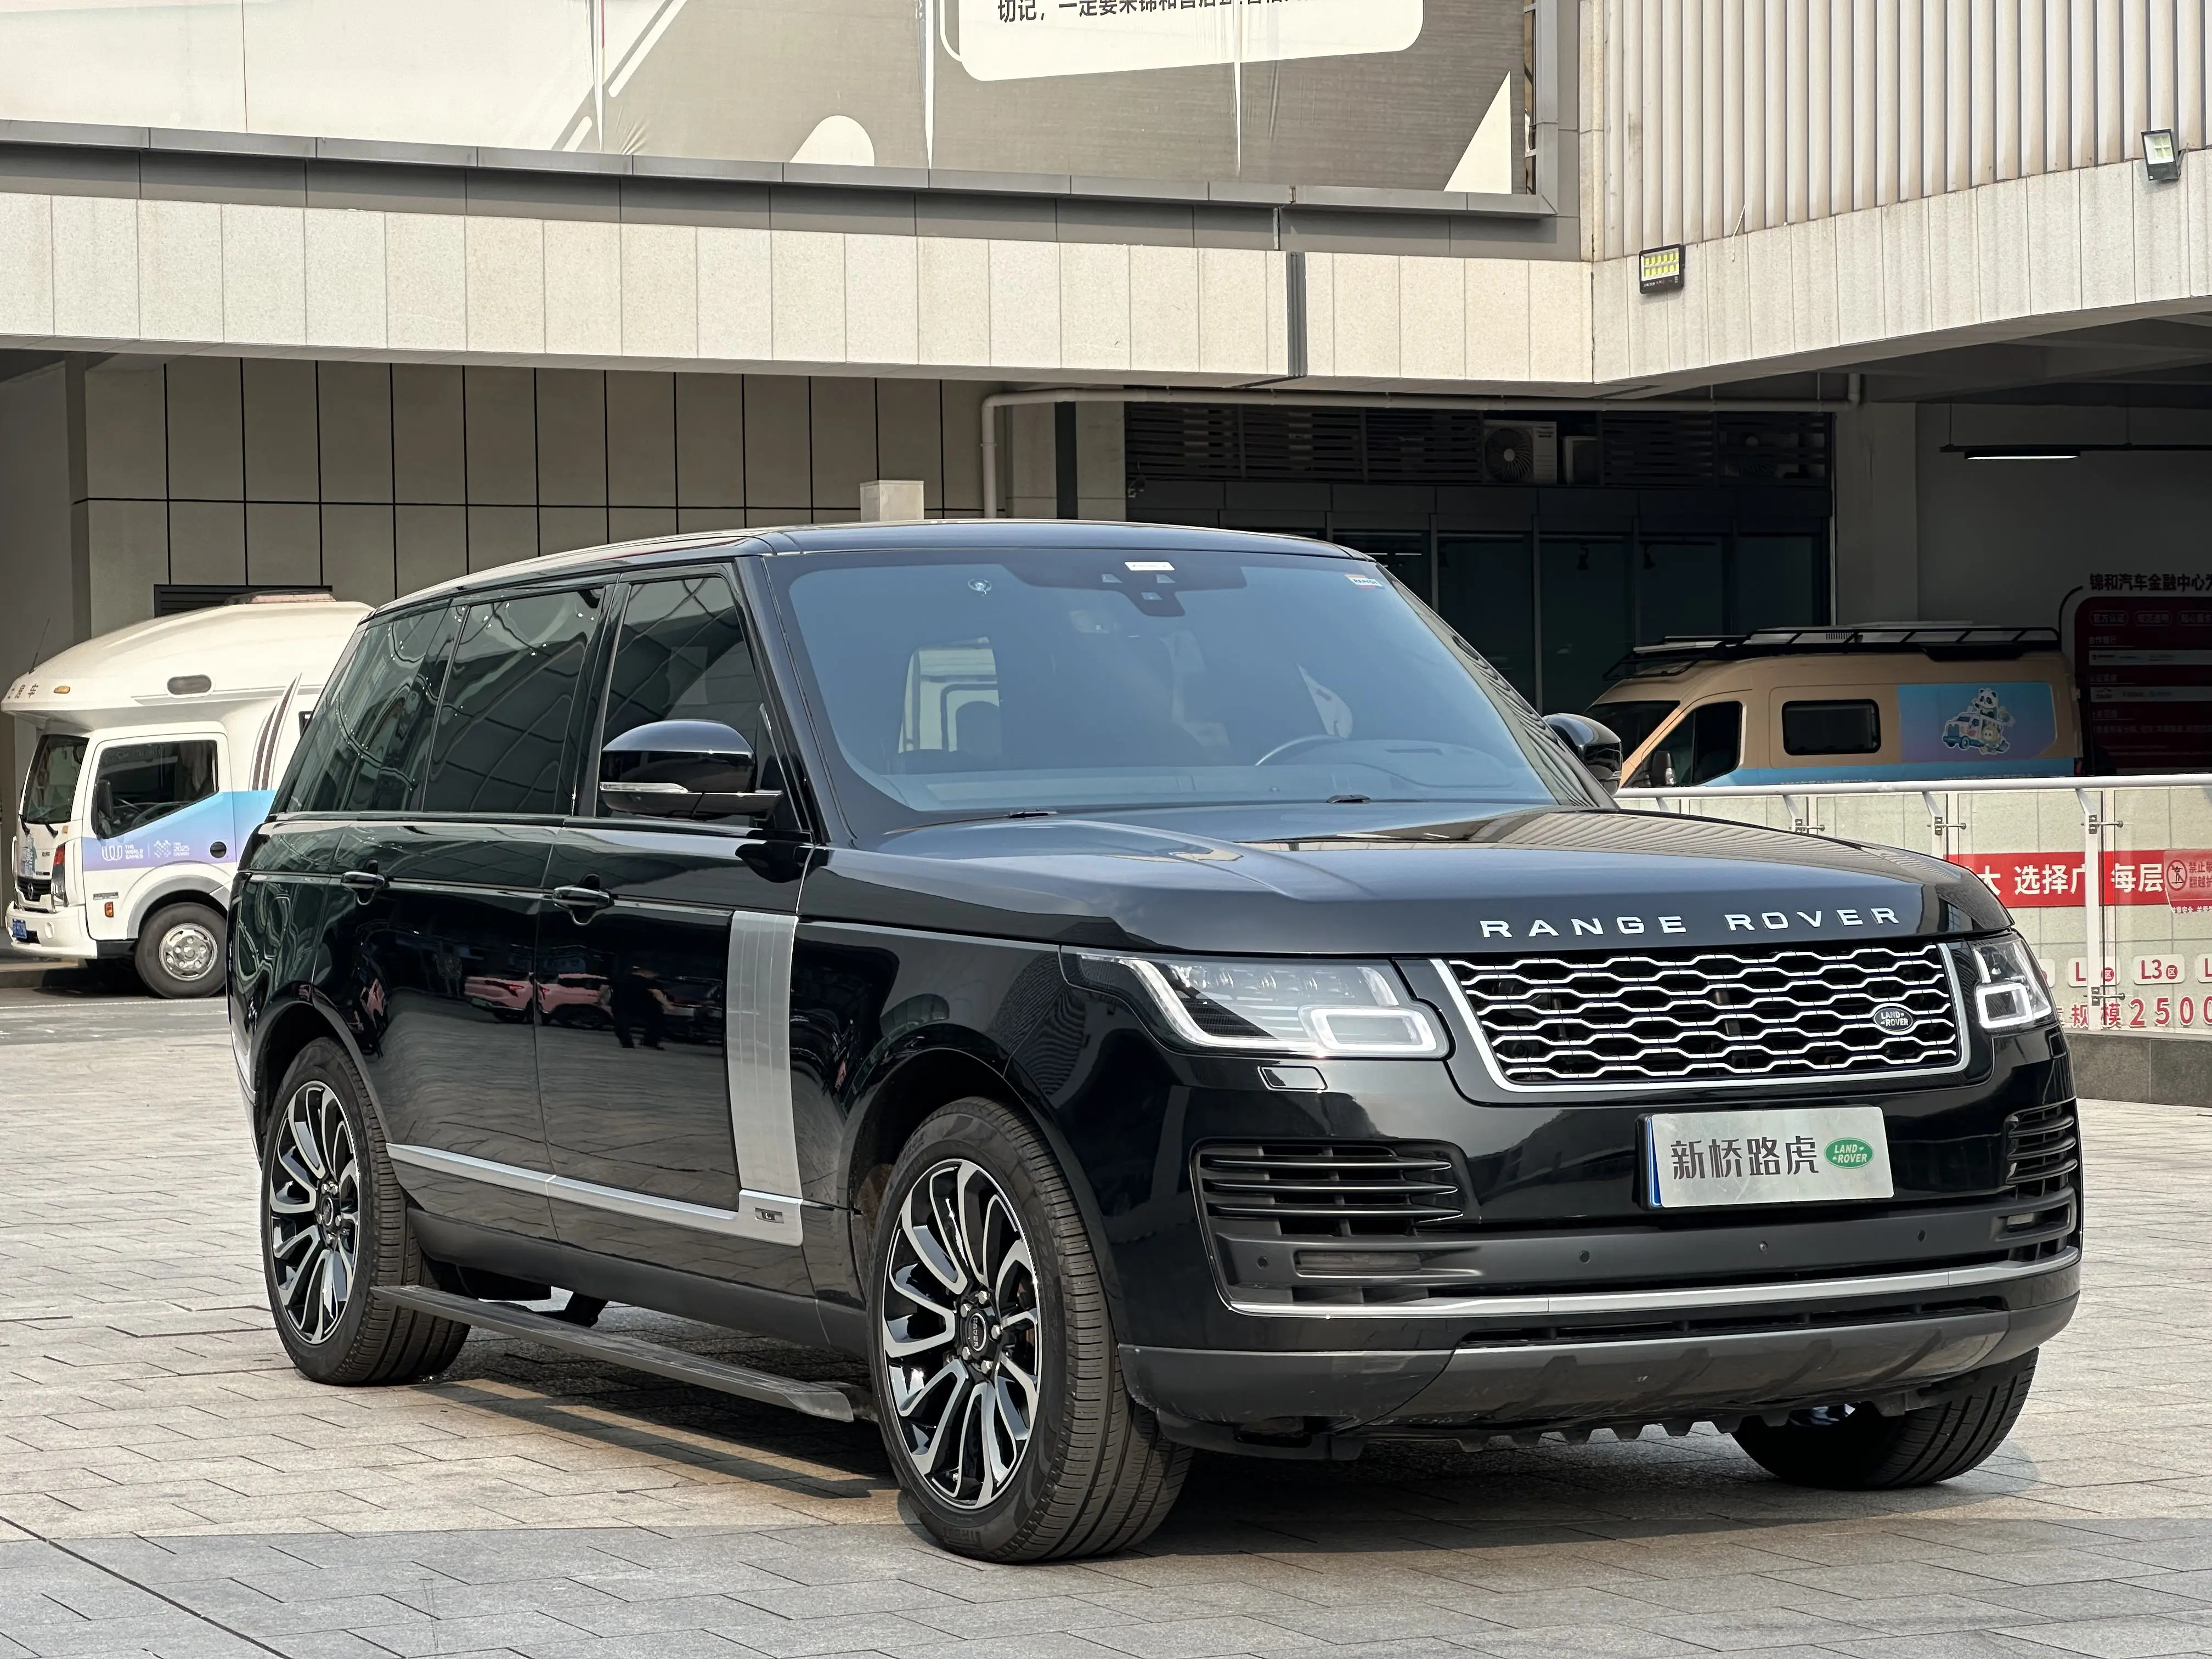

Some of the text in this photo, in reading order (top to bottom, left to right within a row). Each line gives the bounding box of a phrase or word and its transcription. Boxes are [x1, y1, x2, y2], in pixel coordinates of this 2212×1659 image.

[1480, 907, 1900, 939] RANGE ROVER
[1881, 1011, 1901, 1019] LAND
[1886, 1018, 1909, 1026] ROVER
[1835, 1144, 1858, 1154] LAND
[1671, 1136, 1819, 1180] 新桥路虎
[1837, 1154, 1867, 1163] ROVER
